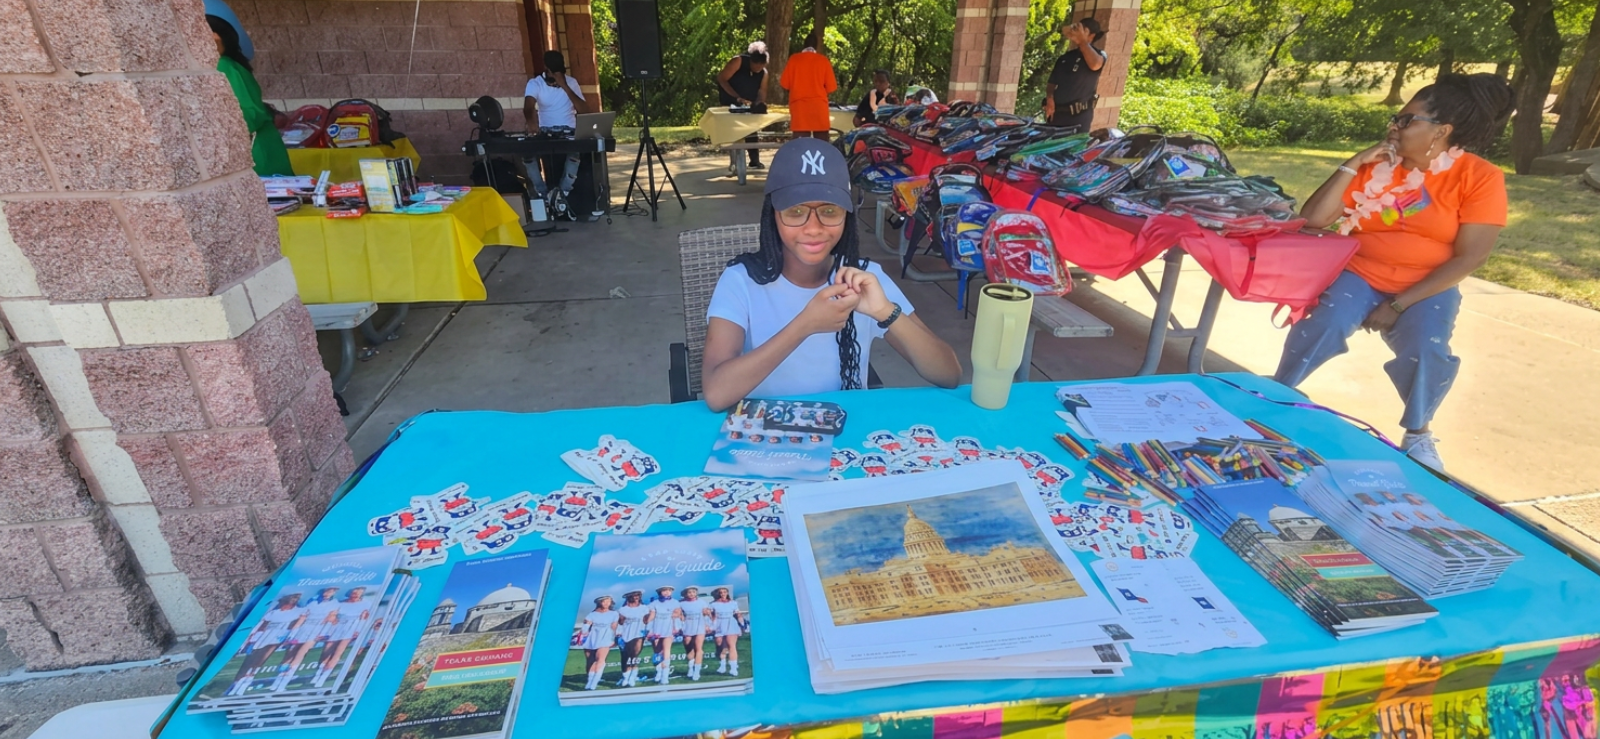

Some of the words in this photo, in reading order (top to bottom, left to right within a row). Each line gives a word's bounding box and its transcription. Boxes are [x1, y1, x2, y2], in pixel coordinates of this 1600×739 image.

[801, 150, 826, 175] NY
[615, 562, 670, 577] Travel
[675, 559, 725, 577] Guide
